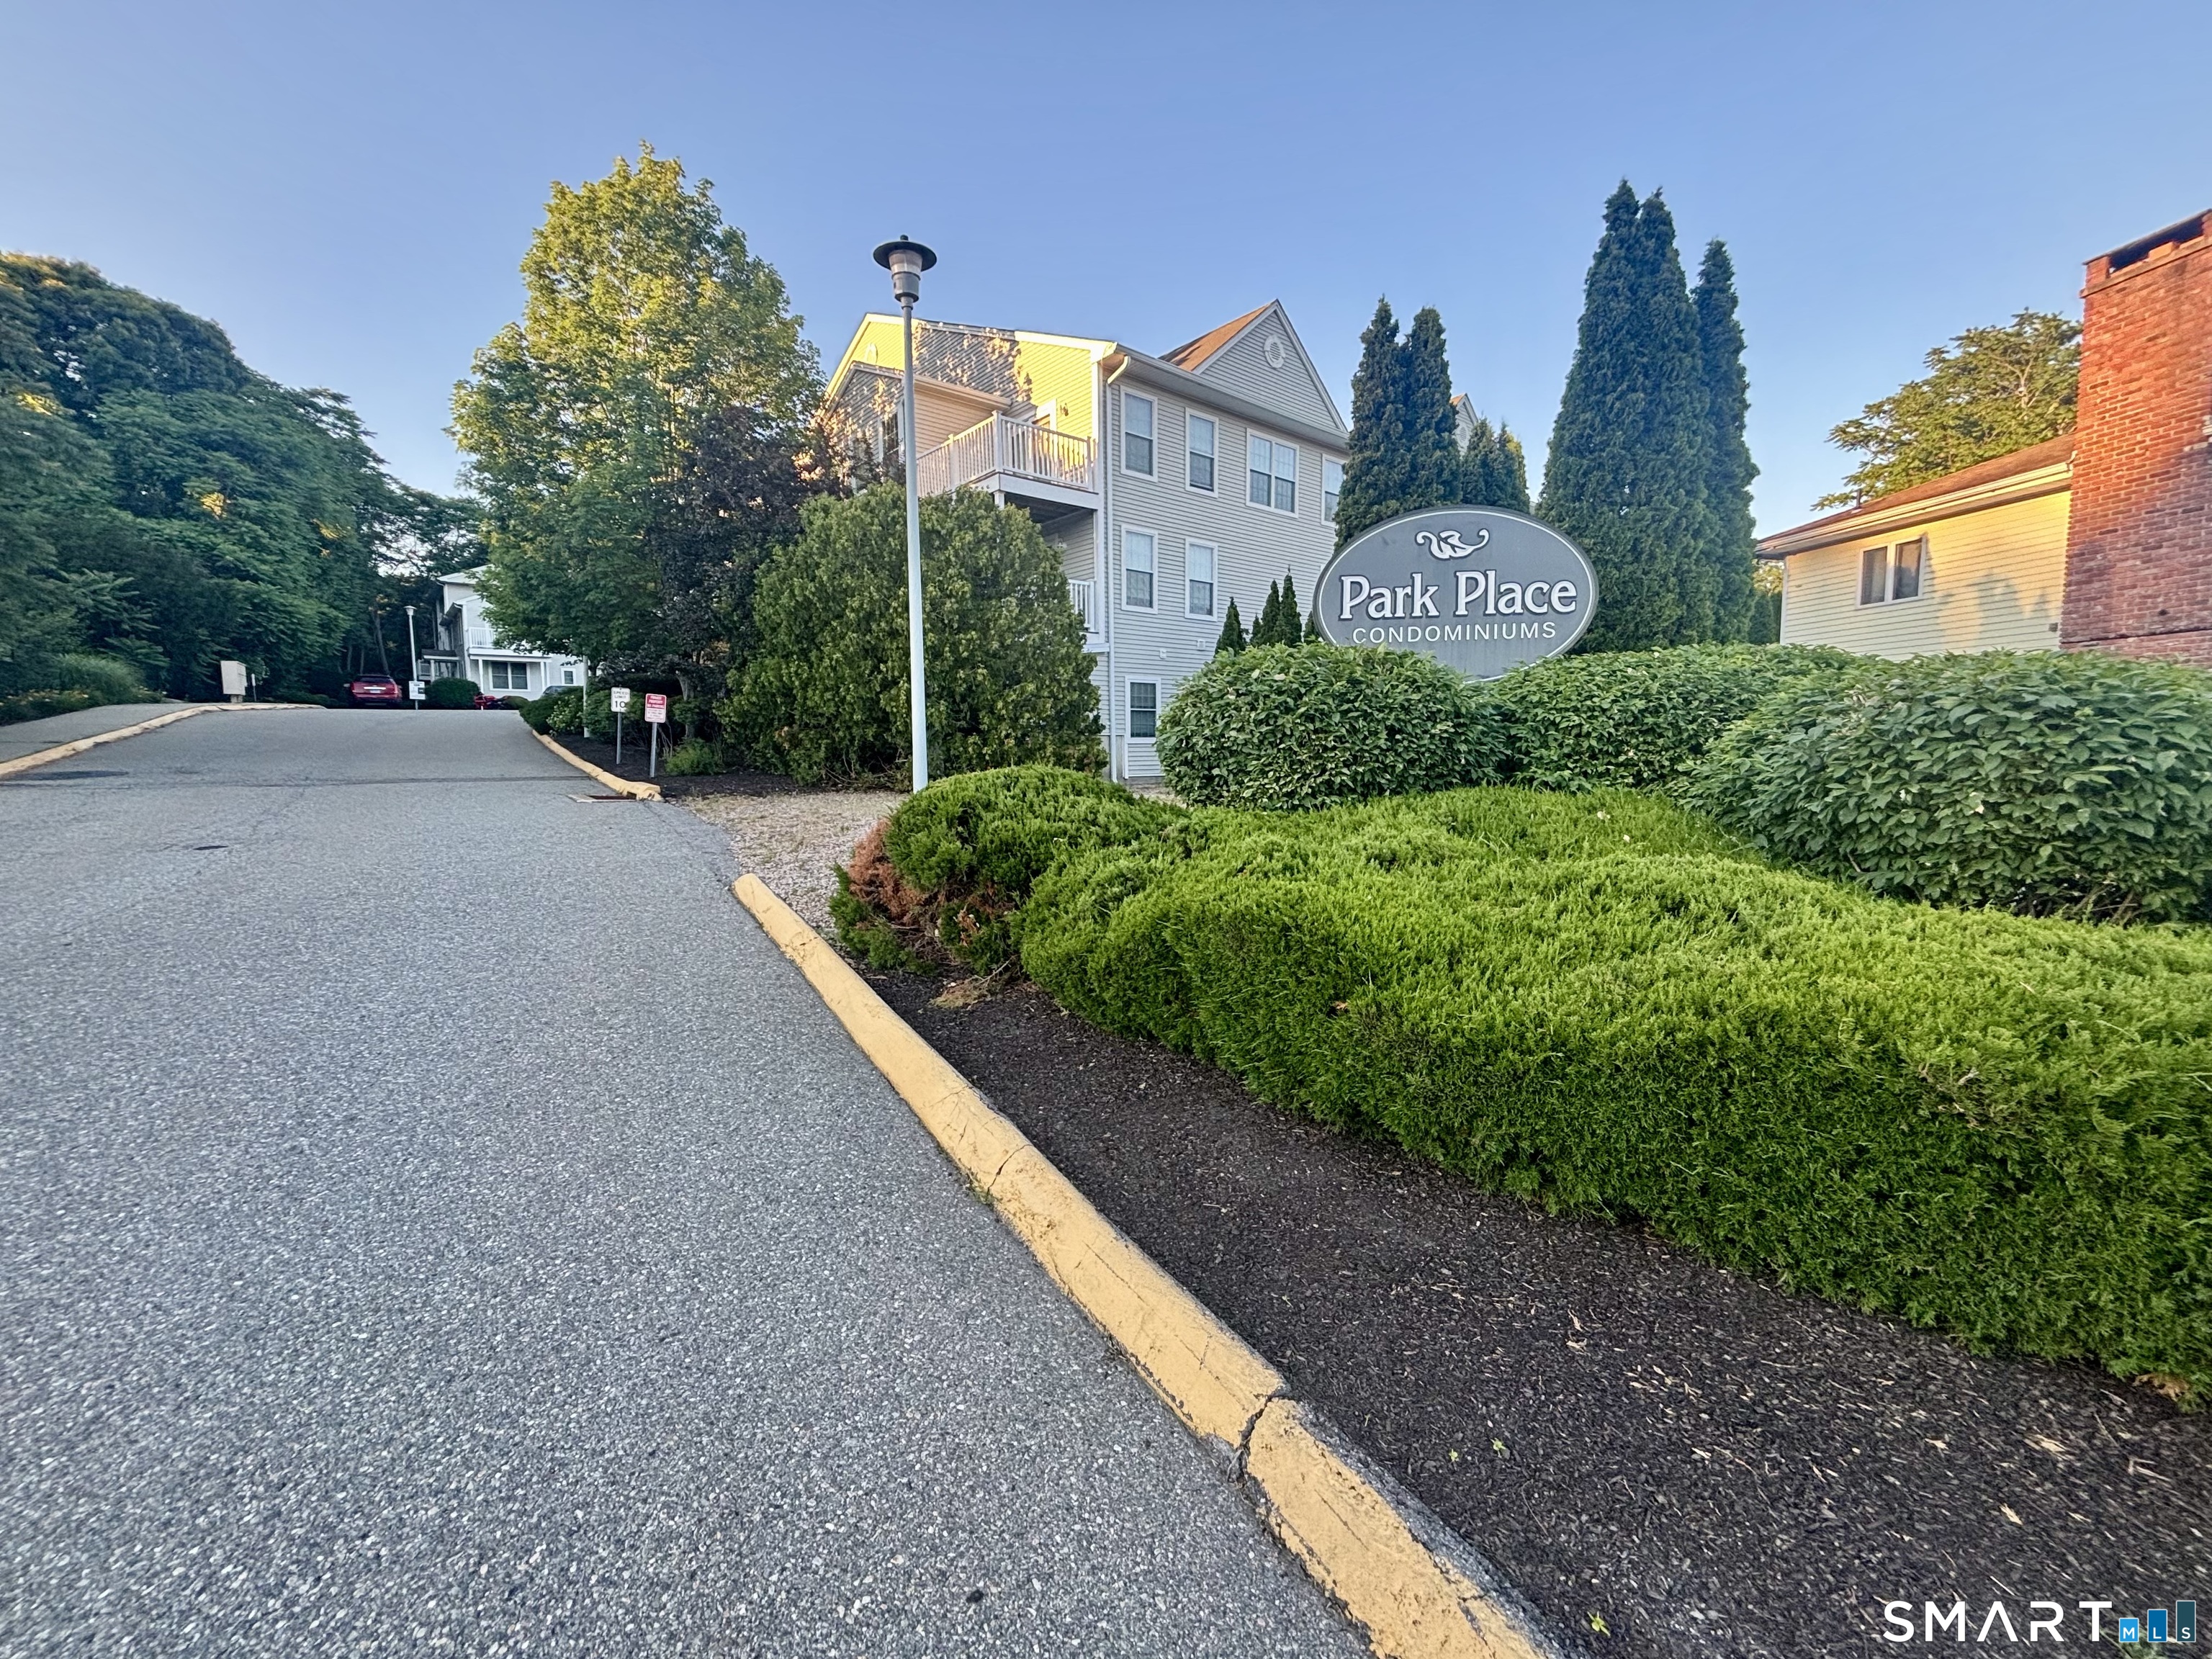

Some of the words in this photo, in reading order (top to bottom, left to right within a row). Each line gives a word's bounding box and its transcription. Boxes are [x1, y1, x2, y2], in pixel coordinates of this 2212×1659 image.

[1339, 572, 1439, 620] Park
[1455, 570, 1578, 616] Place
[1352, 621, 1556, 644] CONDOMINIUMS
